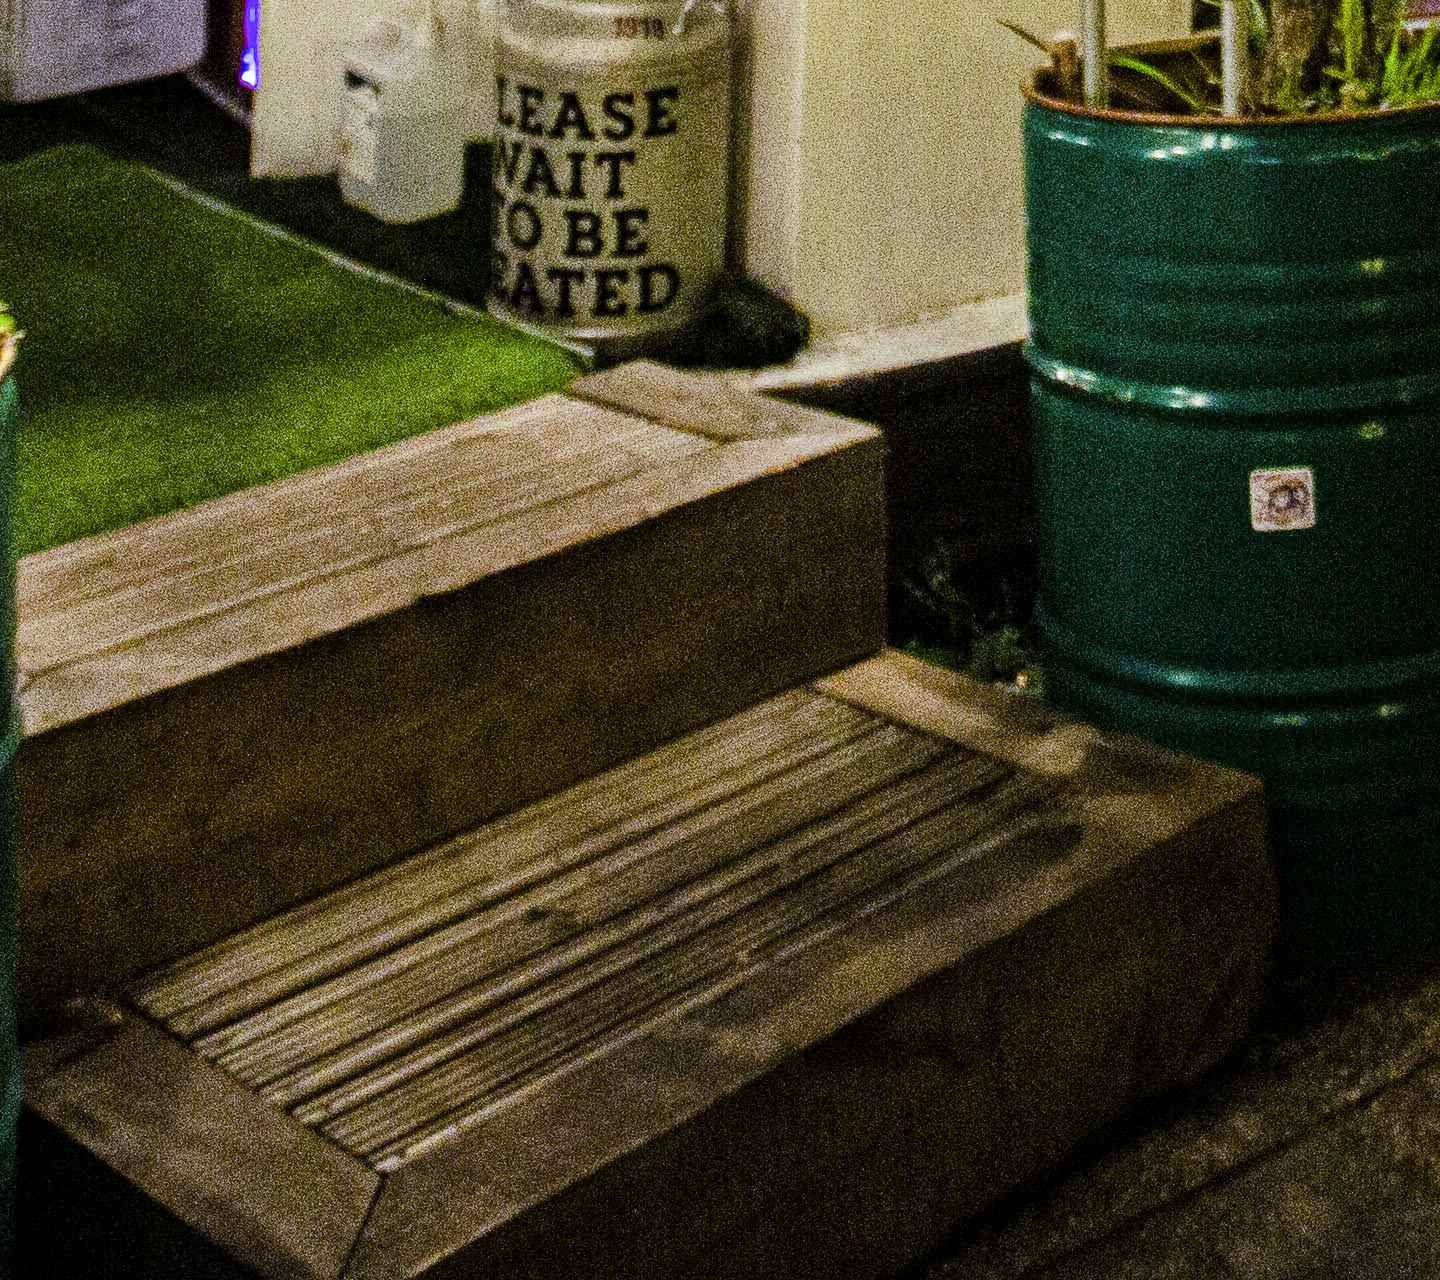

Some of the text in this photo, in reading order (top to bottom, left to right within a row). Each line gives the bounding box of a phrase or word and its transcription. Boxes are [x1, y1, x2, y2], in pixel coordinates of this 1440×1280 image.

[496, 76, 679, 141] LEASE
[506, 199, 650, 259] O BE
